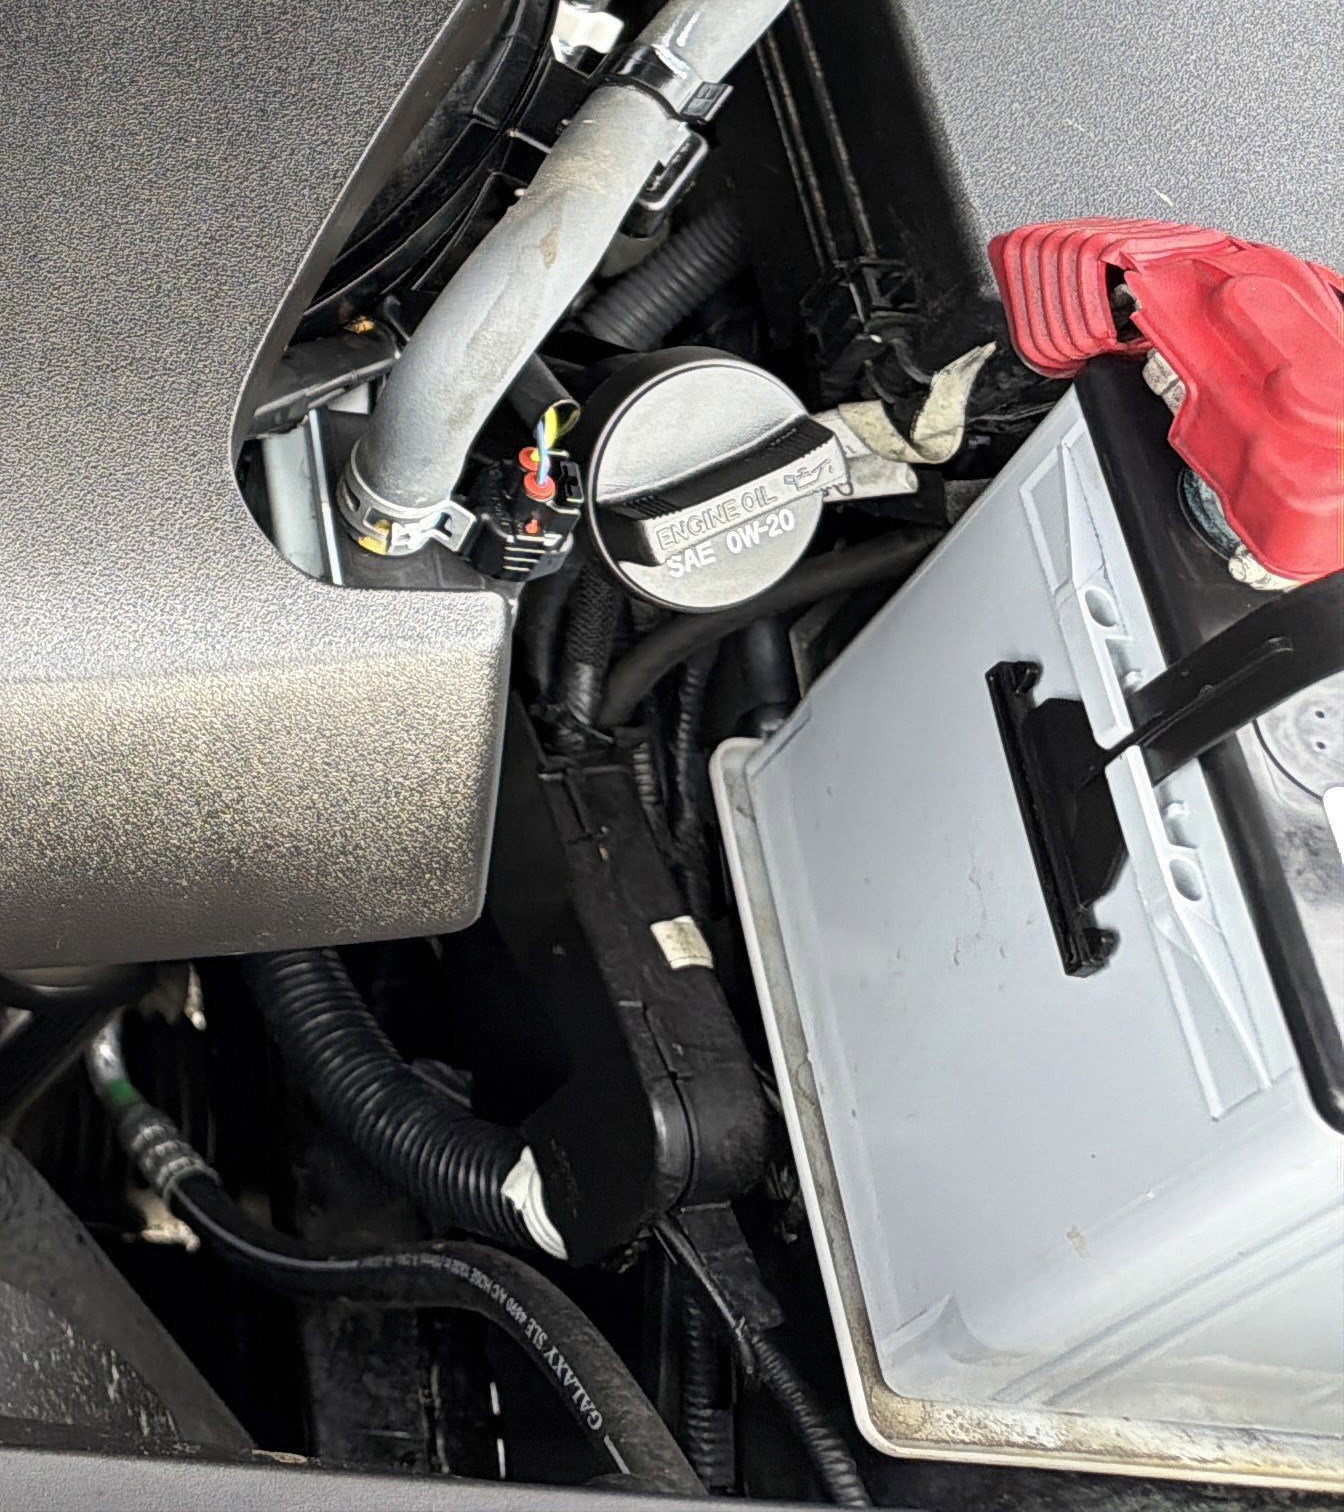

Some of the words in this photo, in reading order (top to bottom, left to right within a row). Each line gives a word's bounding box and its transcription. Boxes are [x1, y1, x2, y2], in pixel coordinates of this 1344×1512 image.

[655, 498, 741, 551] ENGINE
[741, 485, 779, 513] OIL
[666, 541, 717, 578] SAE
[725, 508, 796, 554] 0W-20
[525, 1317, 549, 1350] SLE
[543, 1345, 604, 1431] GALAXY
